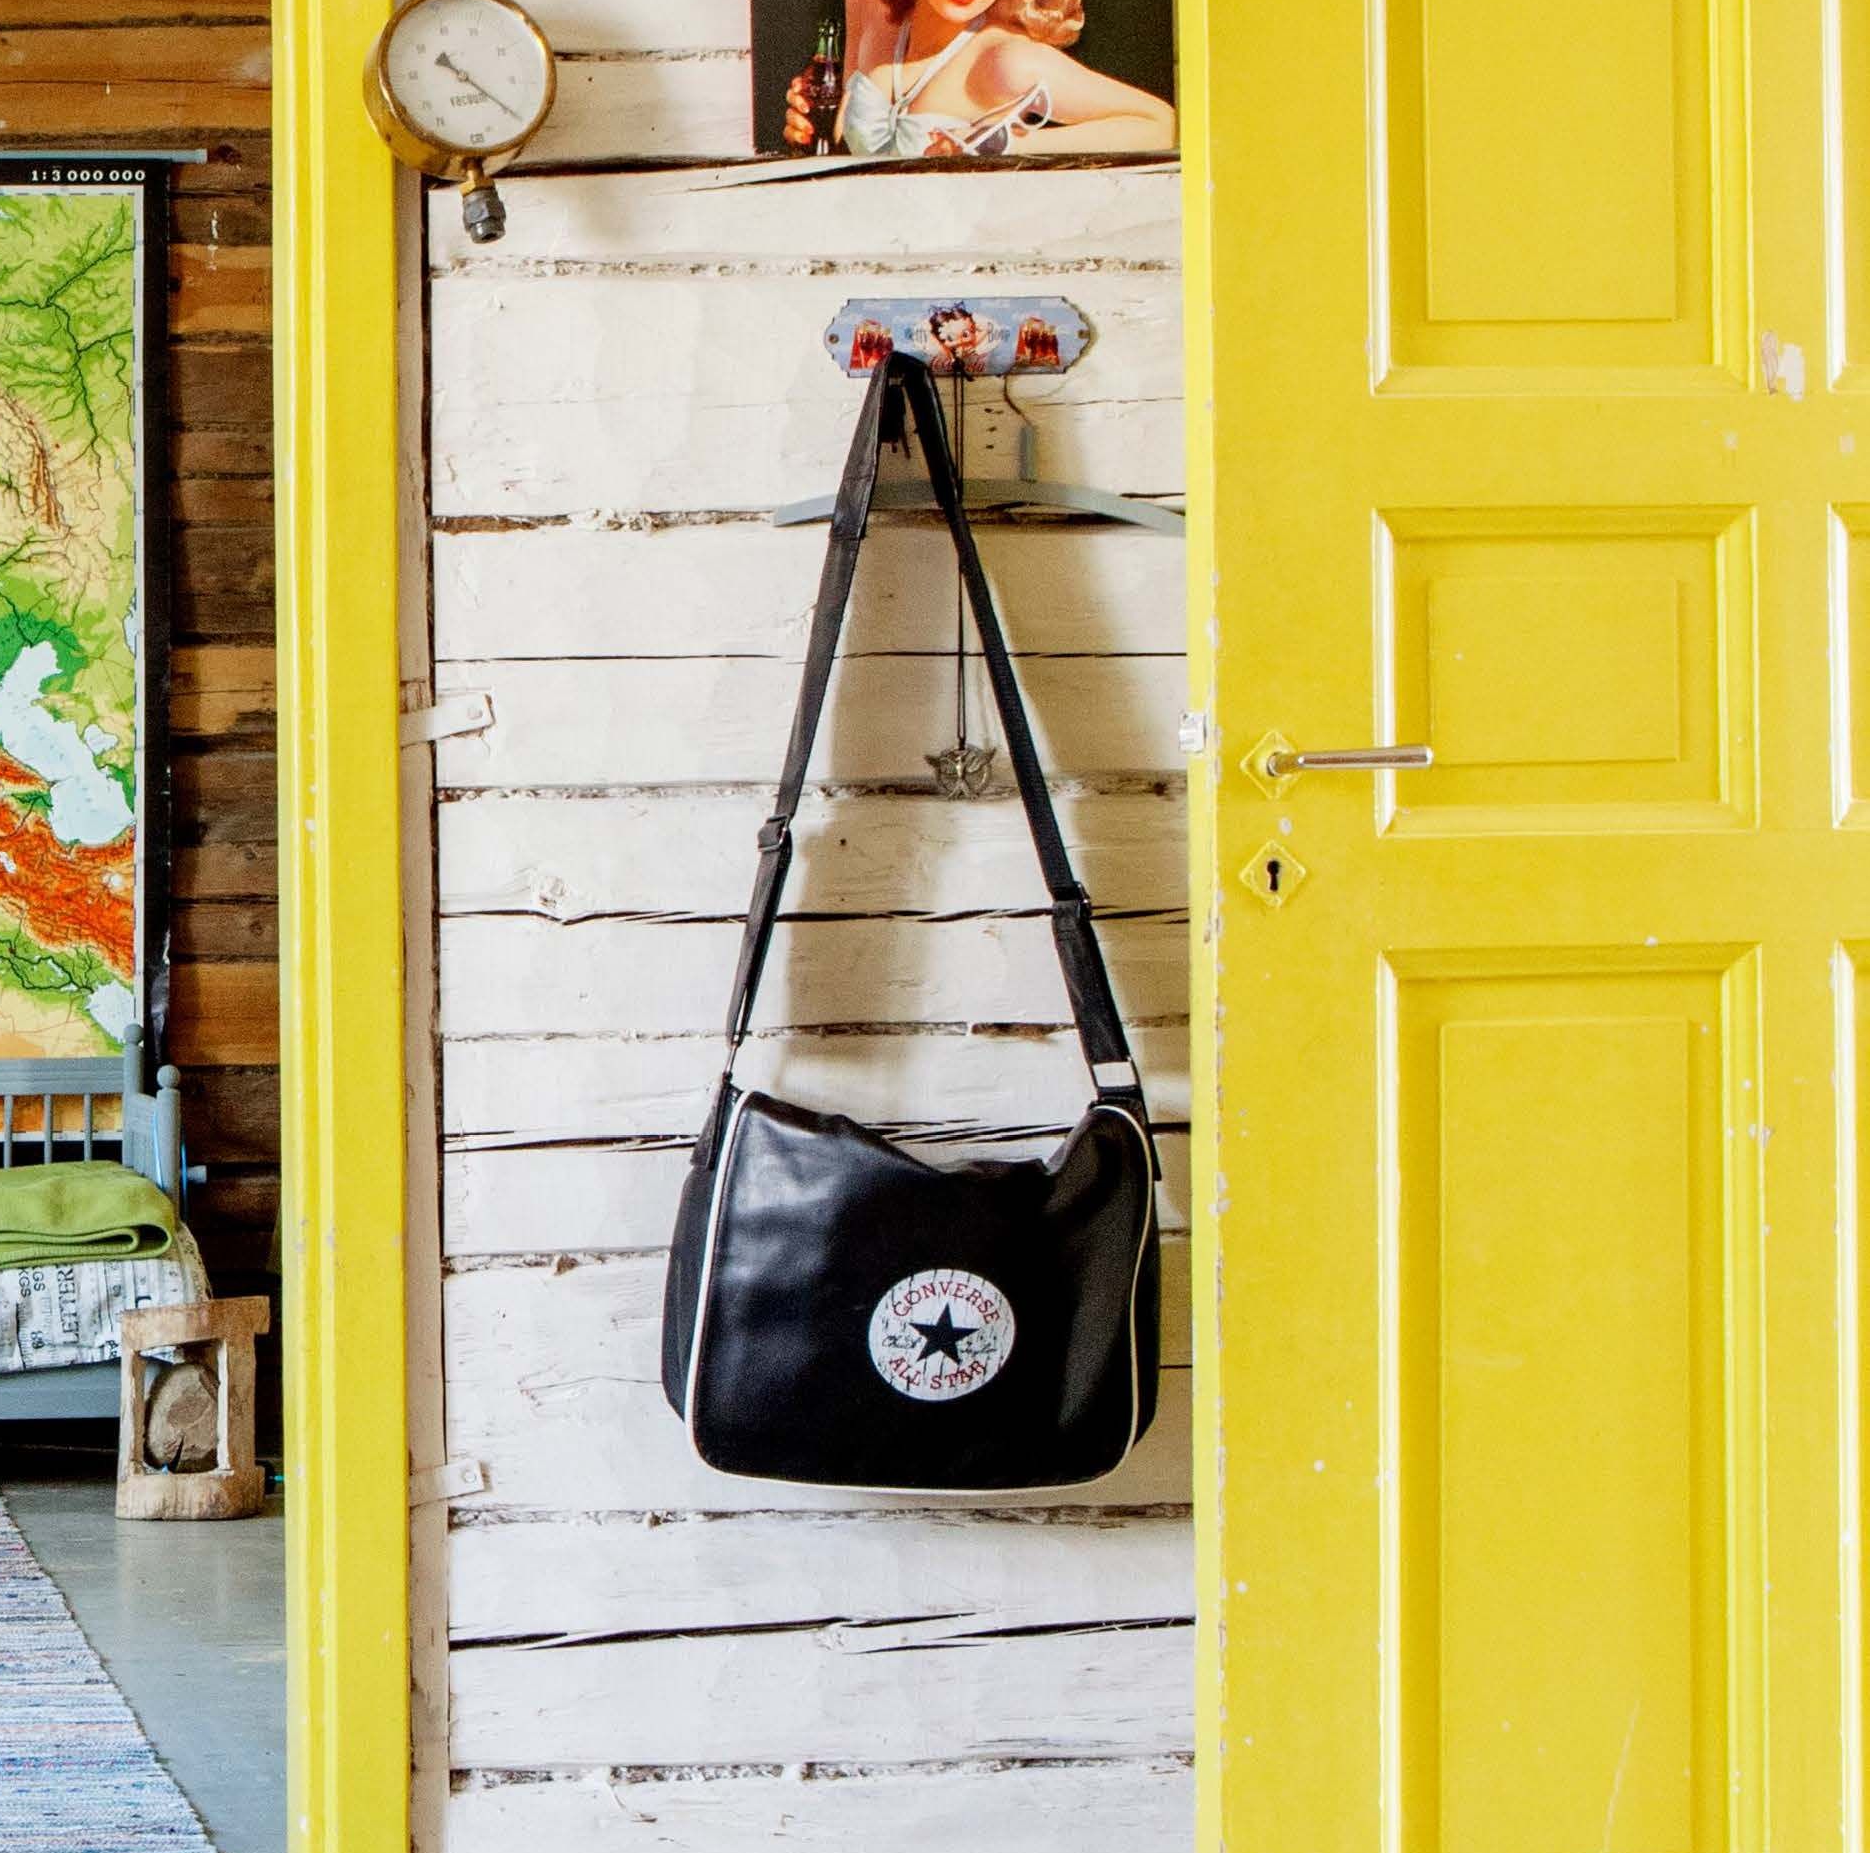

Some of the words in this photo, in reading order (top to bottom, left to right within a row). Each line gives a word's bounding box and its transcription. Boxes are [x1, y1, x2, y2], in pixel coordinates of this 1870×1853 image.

[892, 1280, 1001, 1325] CONVERSE
[888, 1355, 922, 1387] ALL
[929, 1359, 987, 1390] STAR
